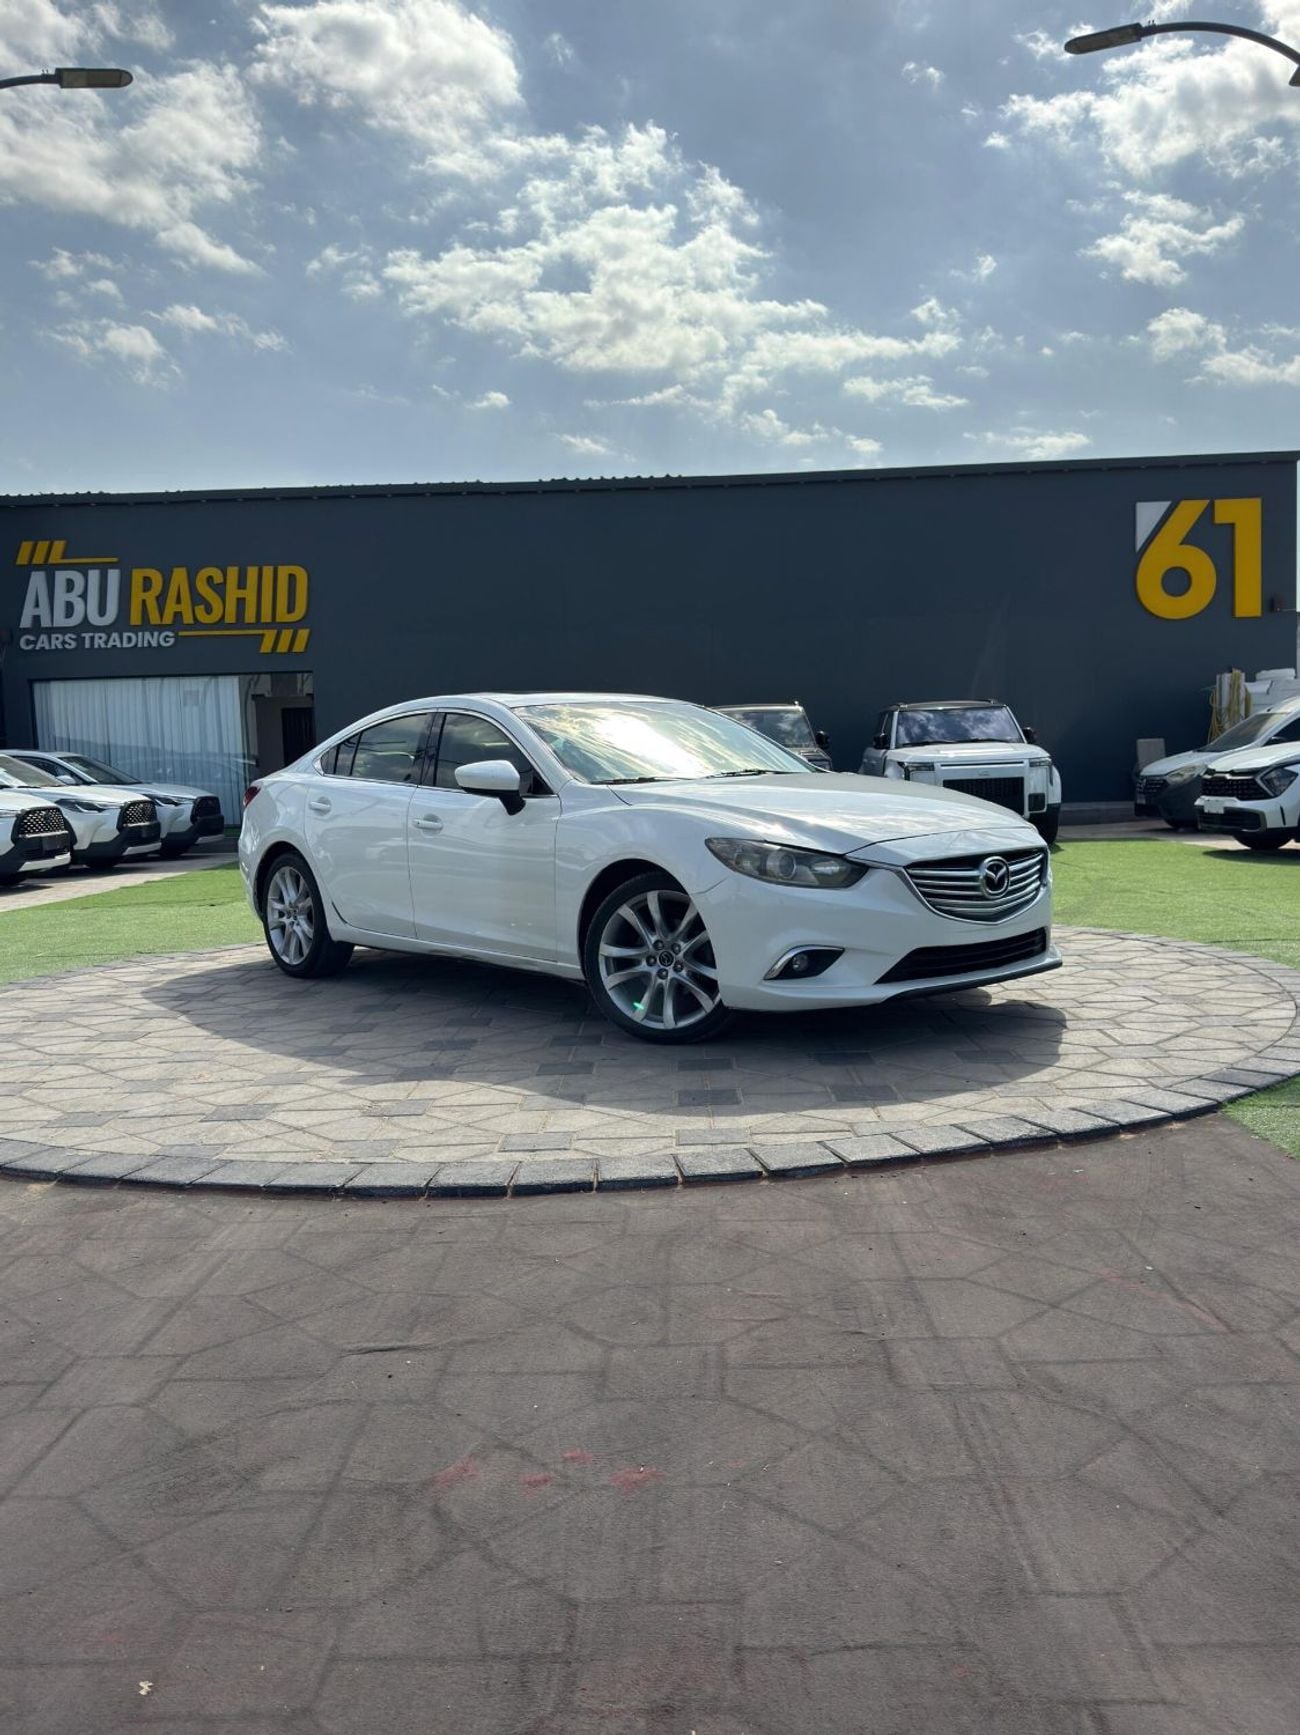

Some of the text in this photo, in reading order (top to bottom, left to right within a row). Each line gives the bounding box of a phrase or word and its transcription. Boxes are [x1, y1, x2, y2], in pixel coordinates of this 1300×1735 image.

[1136, 498, 1262, 620] 61
[19, 565, 309, 628] ABU RASHID
[19, 630, 176, 650] CARS TRADING
